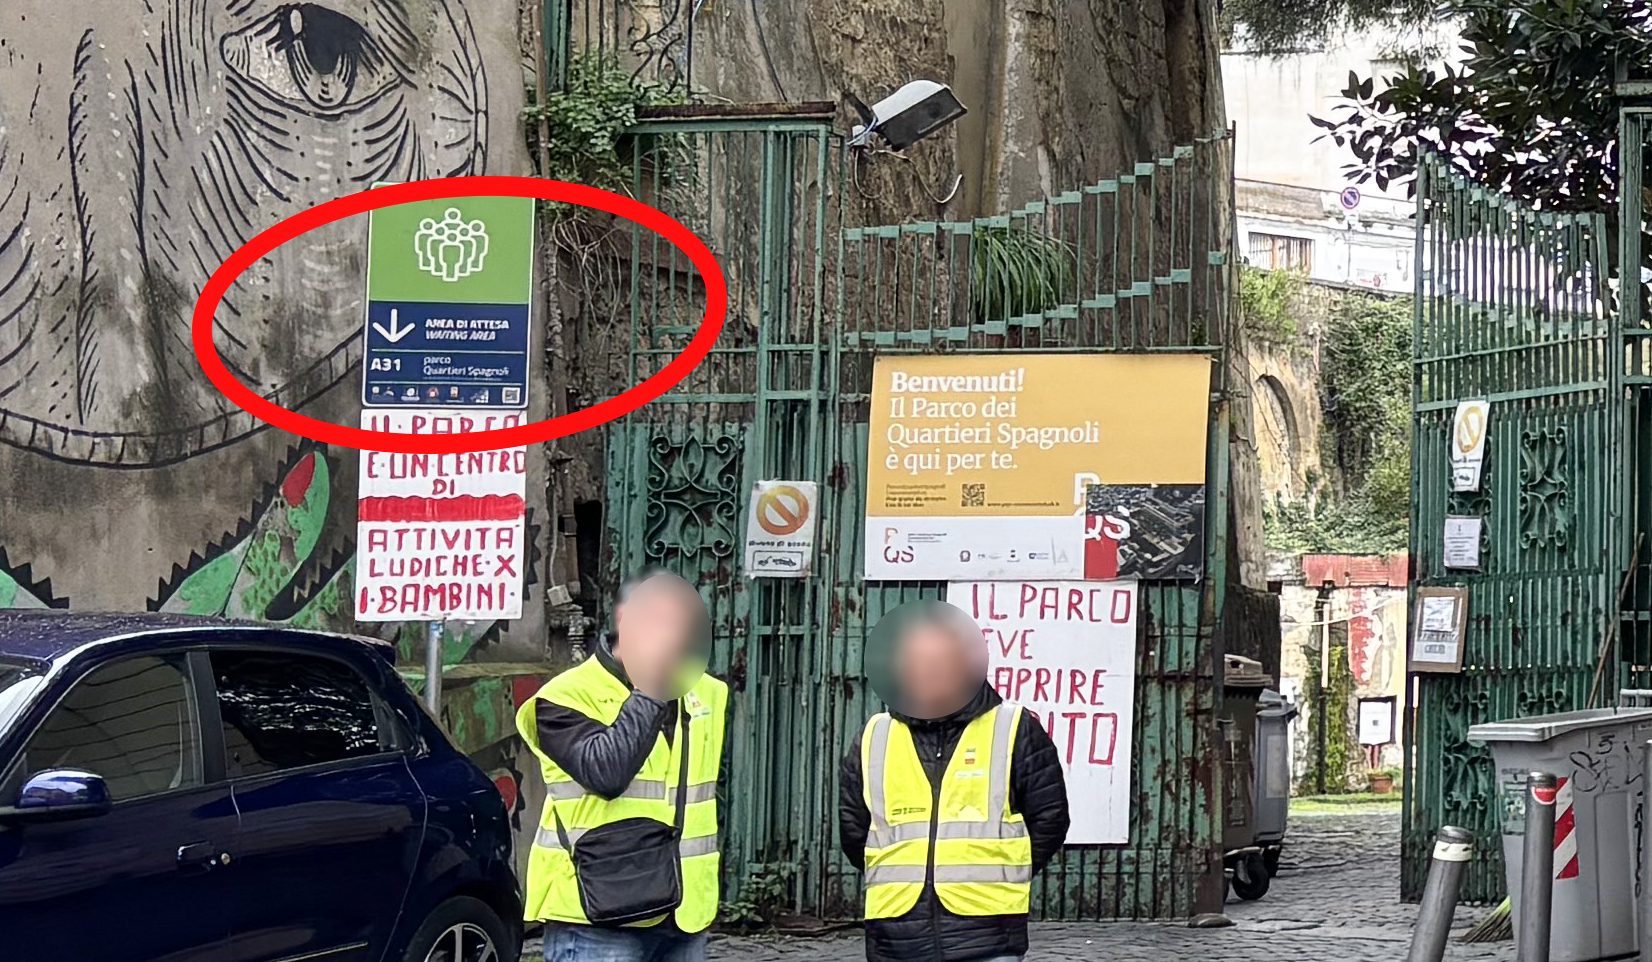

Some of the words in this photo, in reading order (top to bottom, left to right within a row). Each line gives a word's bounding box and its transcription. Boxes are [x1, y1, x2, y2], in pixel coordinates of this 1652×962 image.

[425, 319, 455, 329] AREA
[456, 319, 468, 329] DI
[470, 320, 510, 330] ATTESA
[425, 330, 468, 341] WAITING
[469, 331, 496, 341] AREA
[370, 358, 401, 372] A31
[423, 356, 452, 366] parco
[423, 366, 466, 377] Quartieri
[468, 367, 509, 378] Spagnoli
[889, 368, 1025, 393] Benvenuti!
[889, 397, 905, 418] Il
[911, 397, 977, 418] Parco
[982, 396, 1017, 418] dei
[887, 422, 992, 448] Quartieri
[997, 421, 1100, 449] Spagnoli
[885, 448, 899, 470] è
[903, 450, 940, 474] qui
[946, 452, 984, 475] per
[991, 451, 1018, 470] te.
[432, 478, 455, 495] DI
[884, 545, 914, 563] QS
[369, 554, 484, 578] LUDICHE
[494, 554, 517, 578] X
[377, 582, 505, 613] BAMBINI
[972, 583, 1008, 620] IL
[1019, 584, 1131, 623] PARCO
